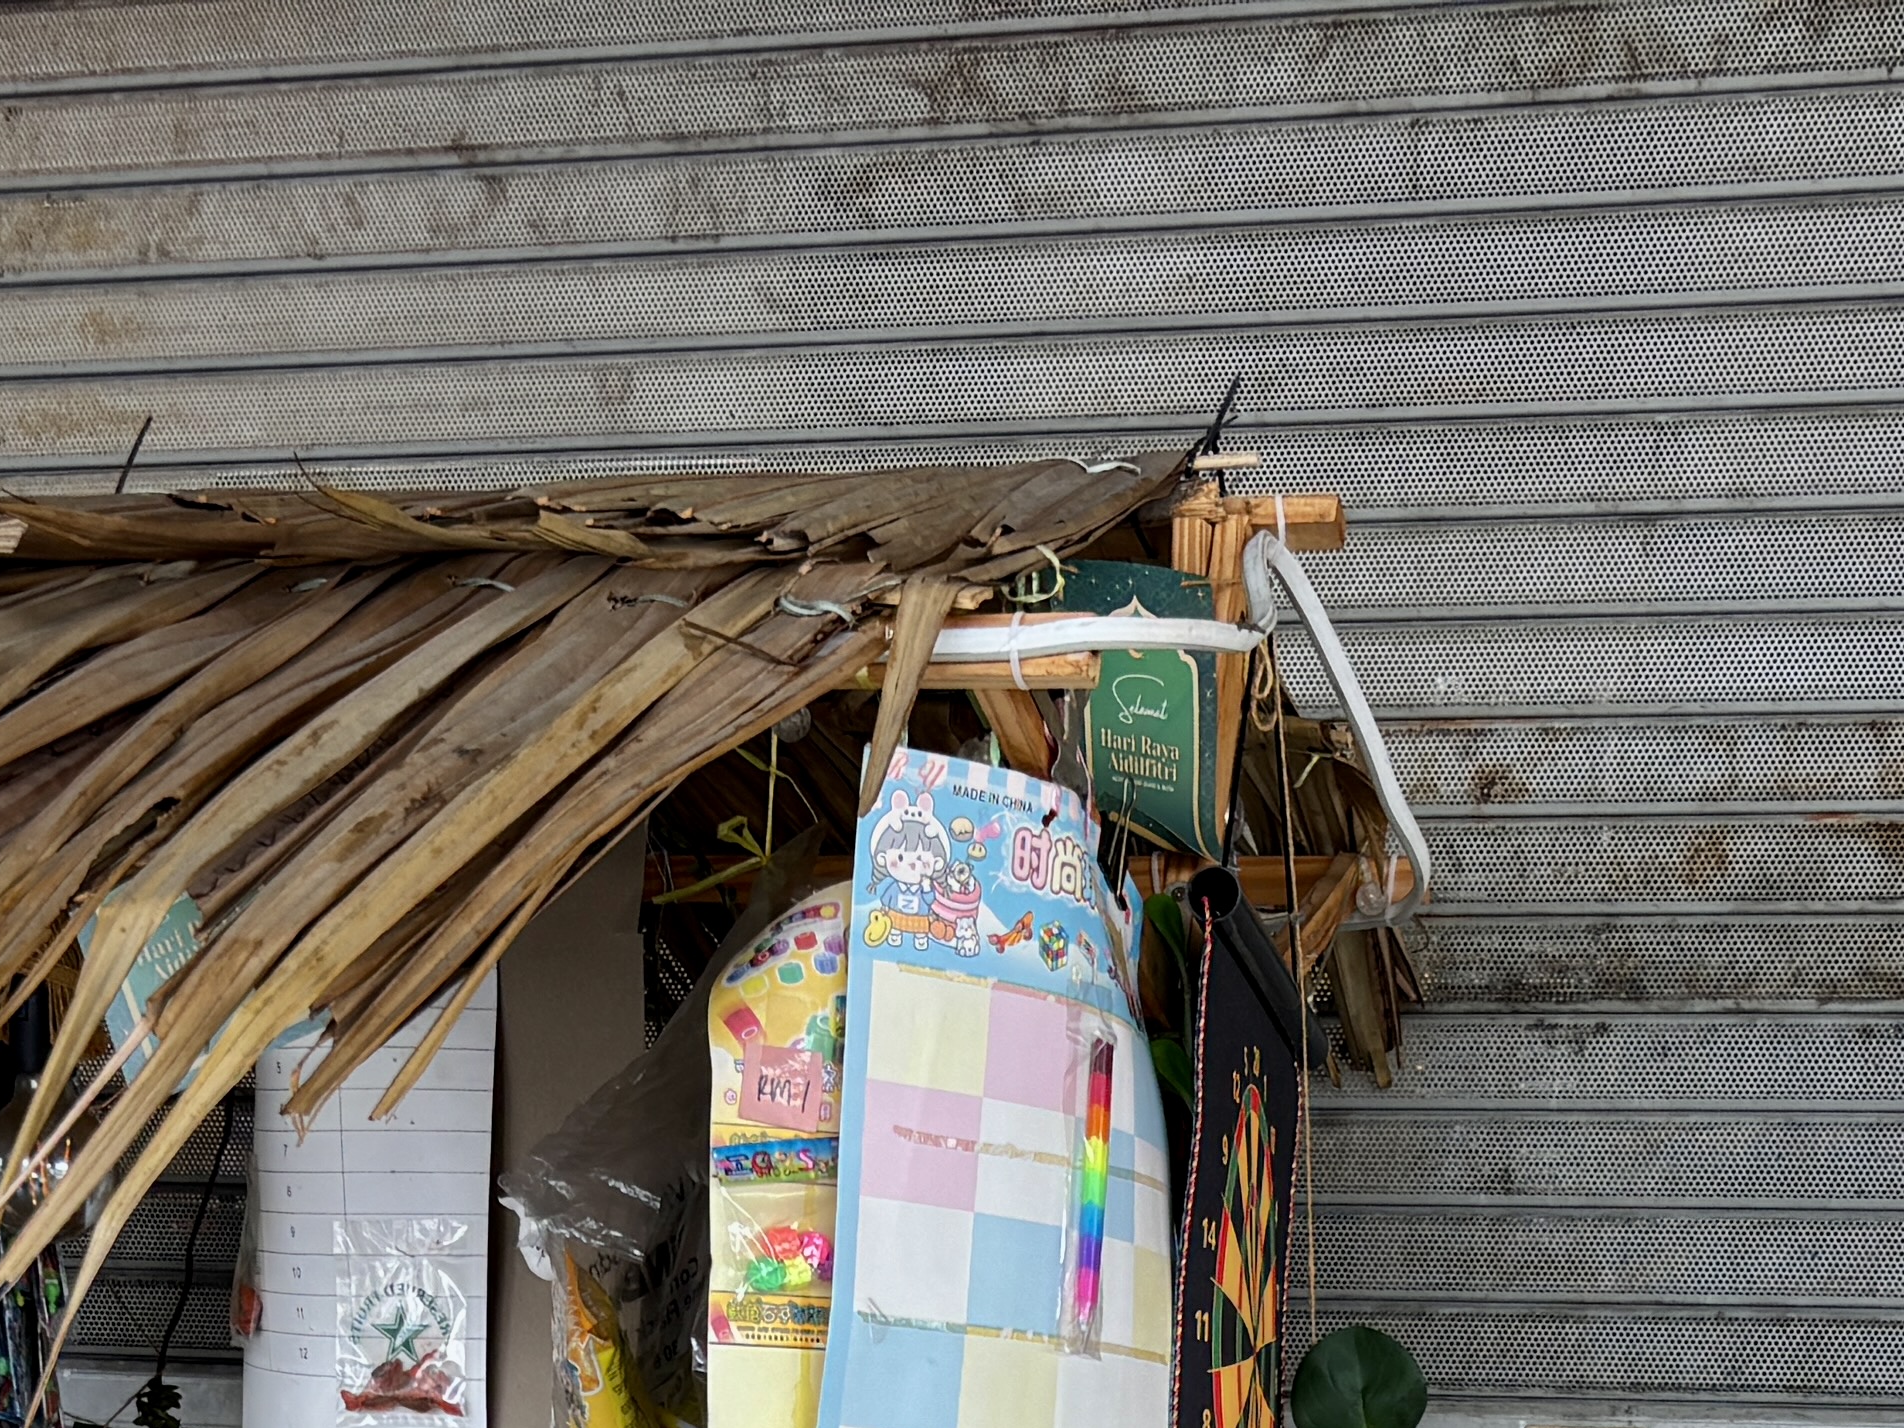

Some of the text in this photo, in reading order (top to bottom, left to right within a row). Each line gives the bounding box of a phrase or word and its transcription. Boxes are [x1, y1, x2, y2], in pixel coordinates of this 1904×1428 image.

[1112, 673, 1169, 724] Selamat
[1101, 727, 1180, 763] Hari Raya
[1108, 752, 1177, 782] Aidilfitri
[953, 784, 1034, 813] MADE IN CHINA
[1202, 1217, 1216, 1252] 14
[1195, 1309, 1210, 1343] 11
